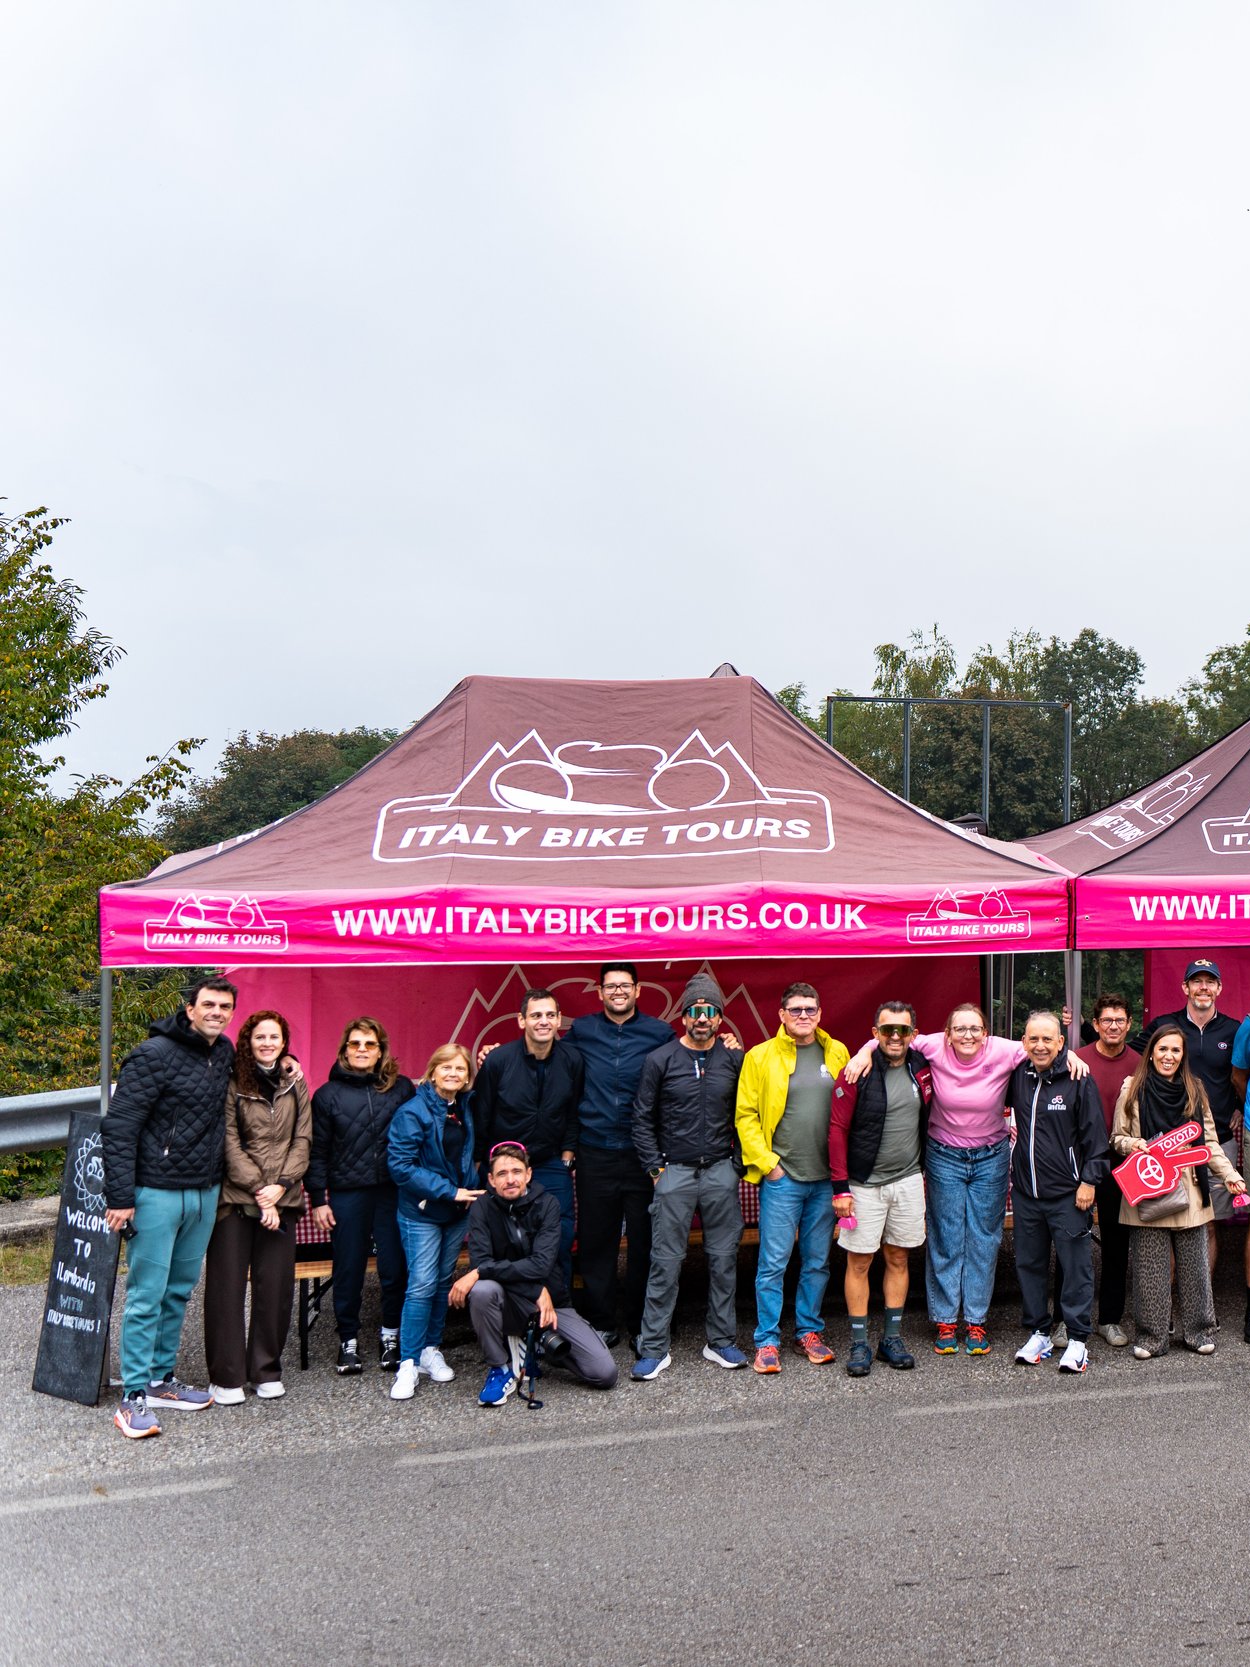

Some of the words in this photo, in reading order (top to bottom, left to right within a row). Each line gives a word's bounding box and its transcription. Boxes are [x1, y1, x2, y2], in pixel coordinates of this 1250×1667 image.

[399, 824, 533, 849] ITALY
[540, 826, 647, 848] BIKE
[660, 818, 812, 845] TOURS
[332, 902, 868, 936] WWW.ITALYBIKETOURS.CO.UK
[913, 925, 949, 937] ITALY
[950, 924, 980, 935] BIKE
[982, 922, 1025, 934] TOURS
[151, 933, 193, 945] ITALY
[194, 933, 229, 945] BIKE
[233, 934, 281, 945] TOURS
[1157, 1127, 1196, 1151] TOYOTA
[66, 1206, 111, 1234] WELCOME
[74, 1238, 92, 1258] TO
[60, 1294, 84, 1311] WITH
